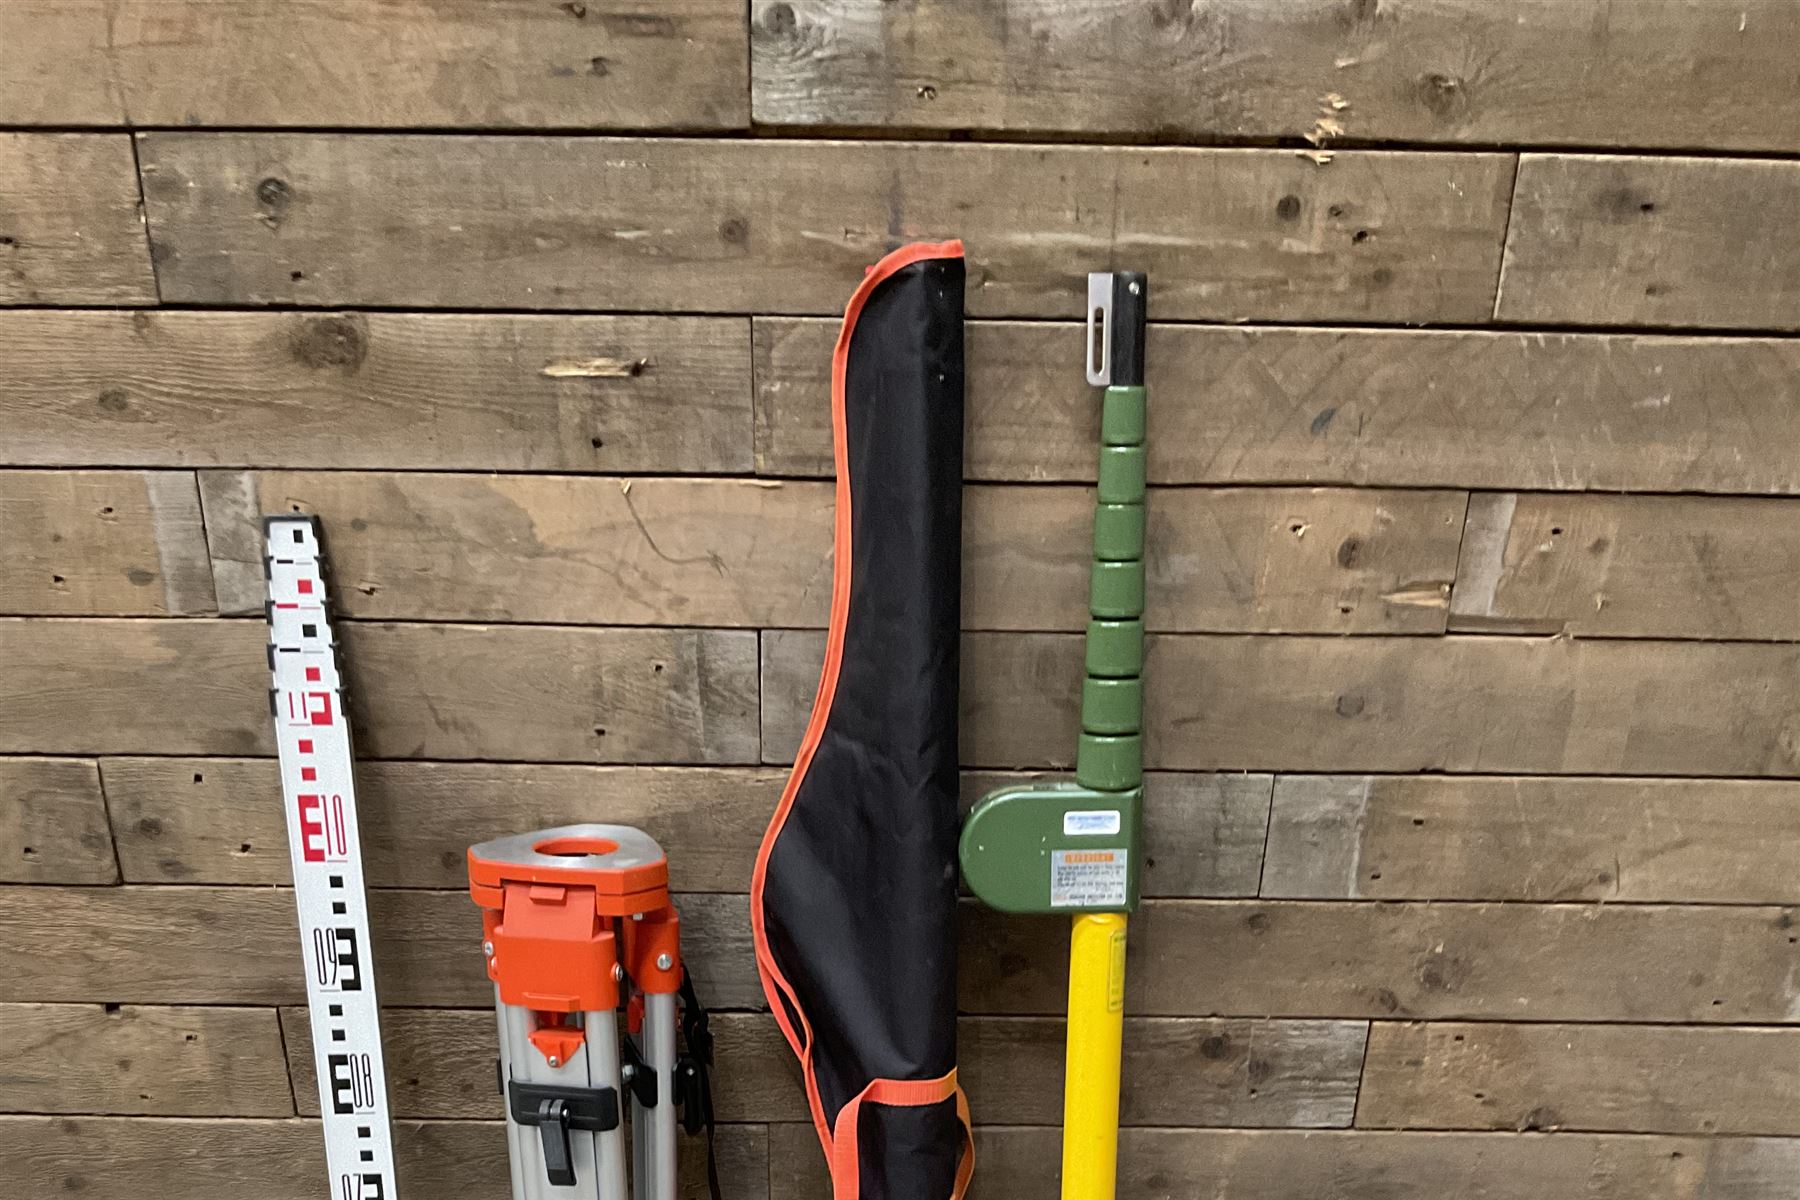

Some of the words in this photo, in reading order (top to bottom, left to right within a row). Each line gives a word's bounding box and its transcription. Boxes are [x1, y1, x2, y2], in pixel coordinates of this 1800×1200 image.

[321, 795, 347, 855] 10
[313, 928, 337, 985] 09
[349, 1053, 374, 1108] 08
